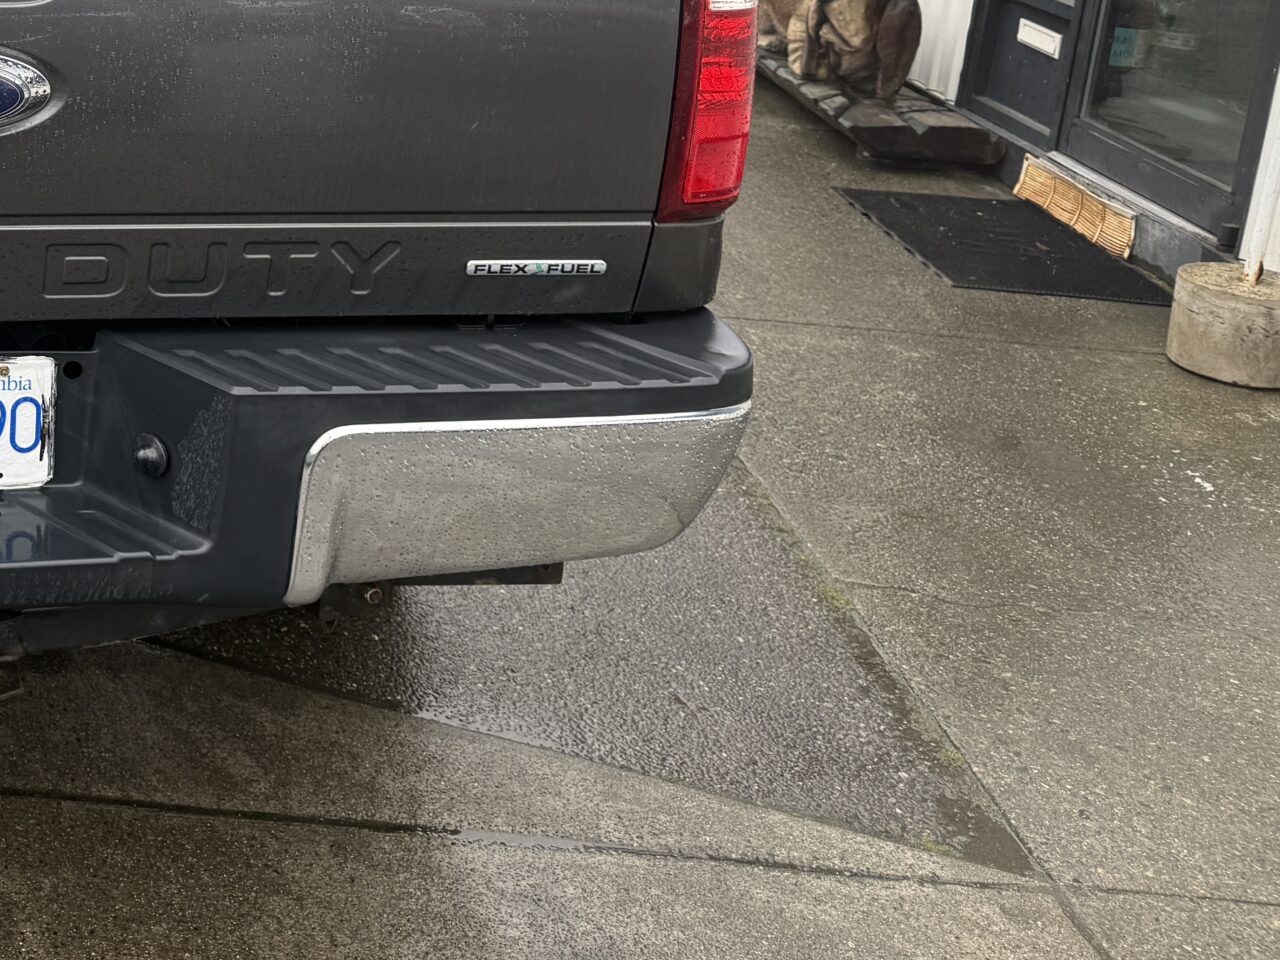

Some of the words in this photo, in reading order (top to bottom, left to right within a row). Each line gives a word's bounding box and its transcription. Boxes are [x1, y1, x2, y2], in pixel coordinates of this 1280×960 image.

[42, 241, 401, 299] DUTY
[473, 263, 528, 274] FLEX
[546, 263, 601, 274] FUEL
